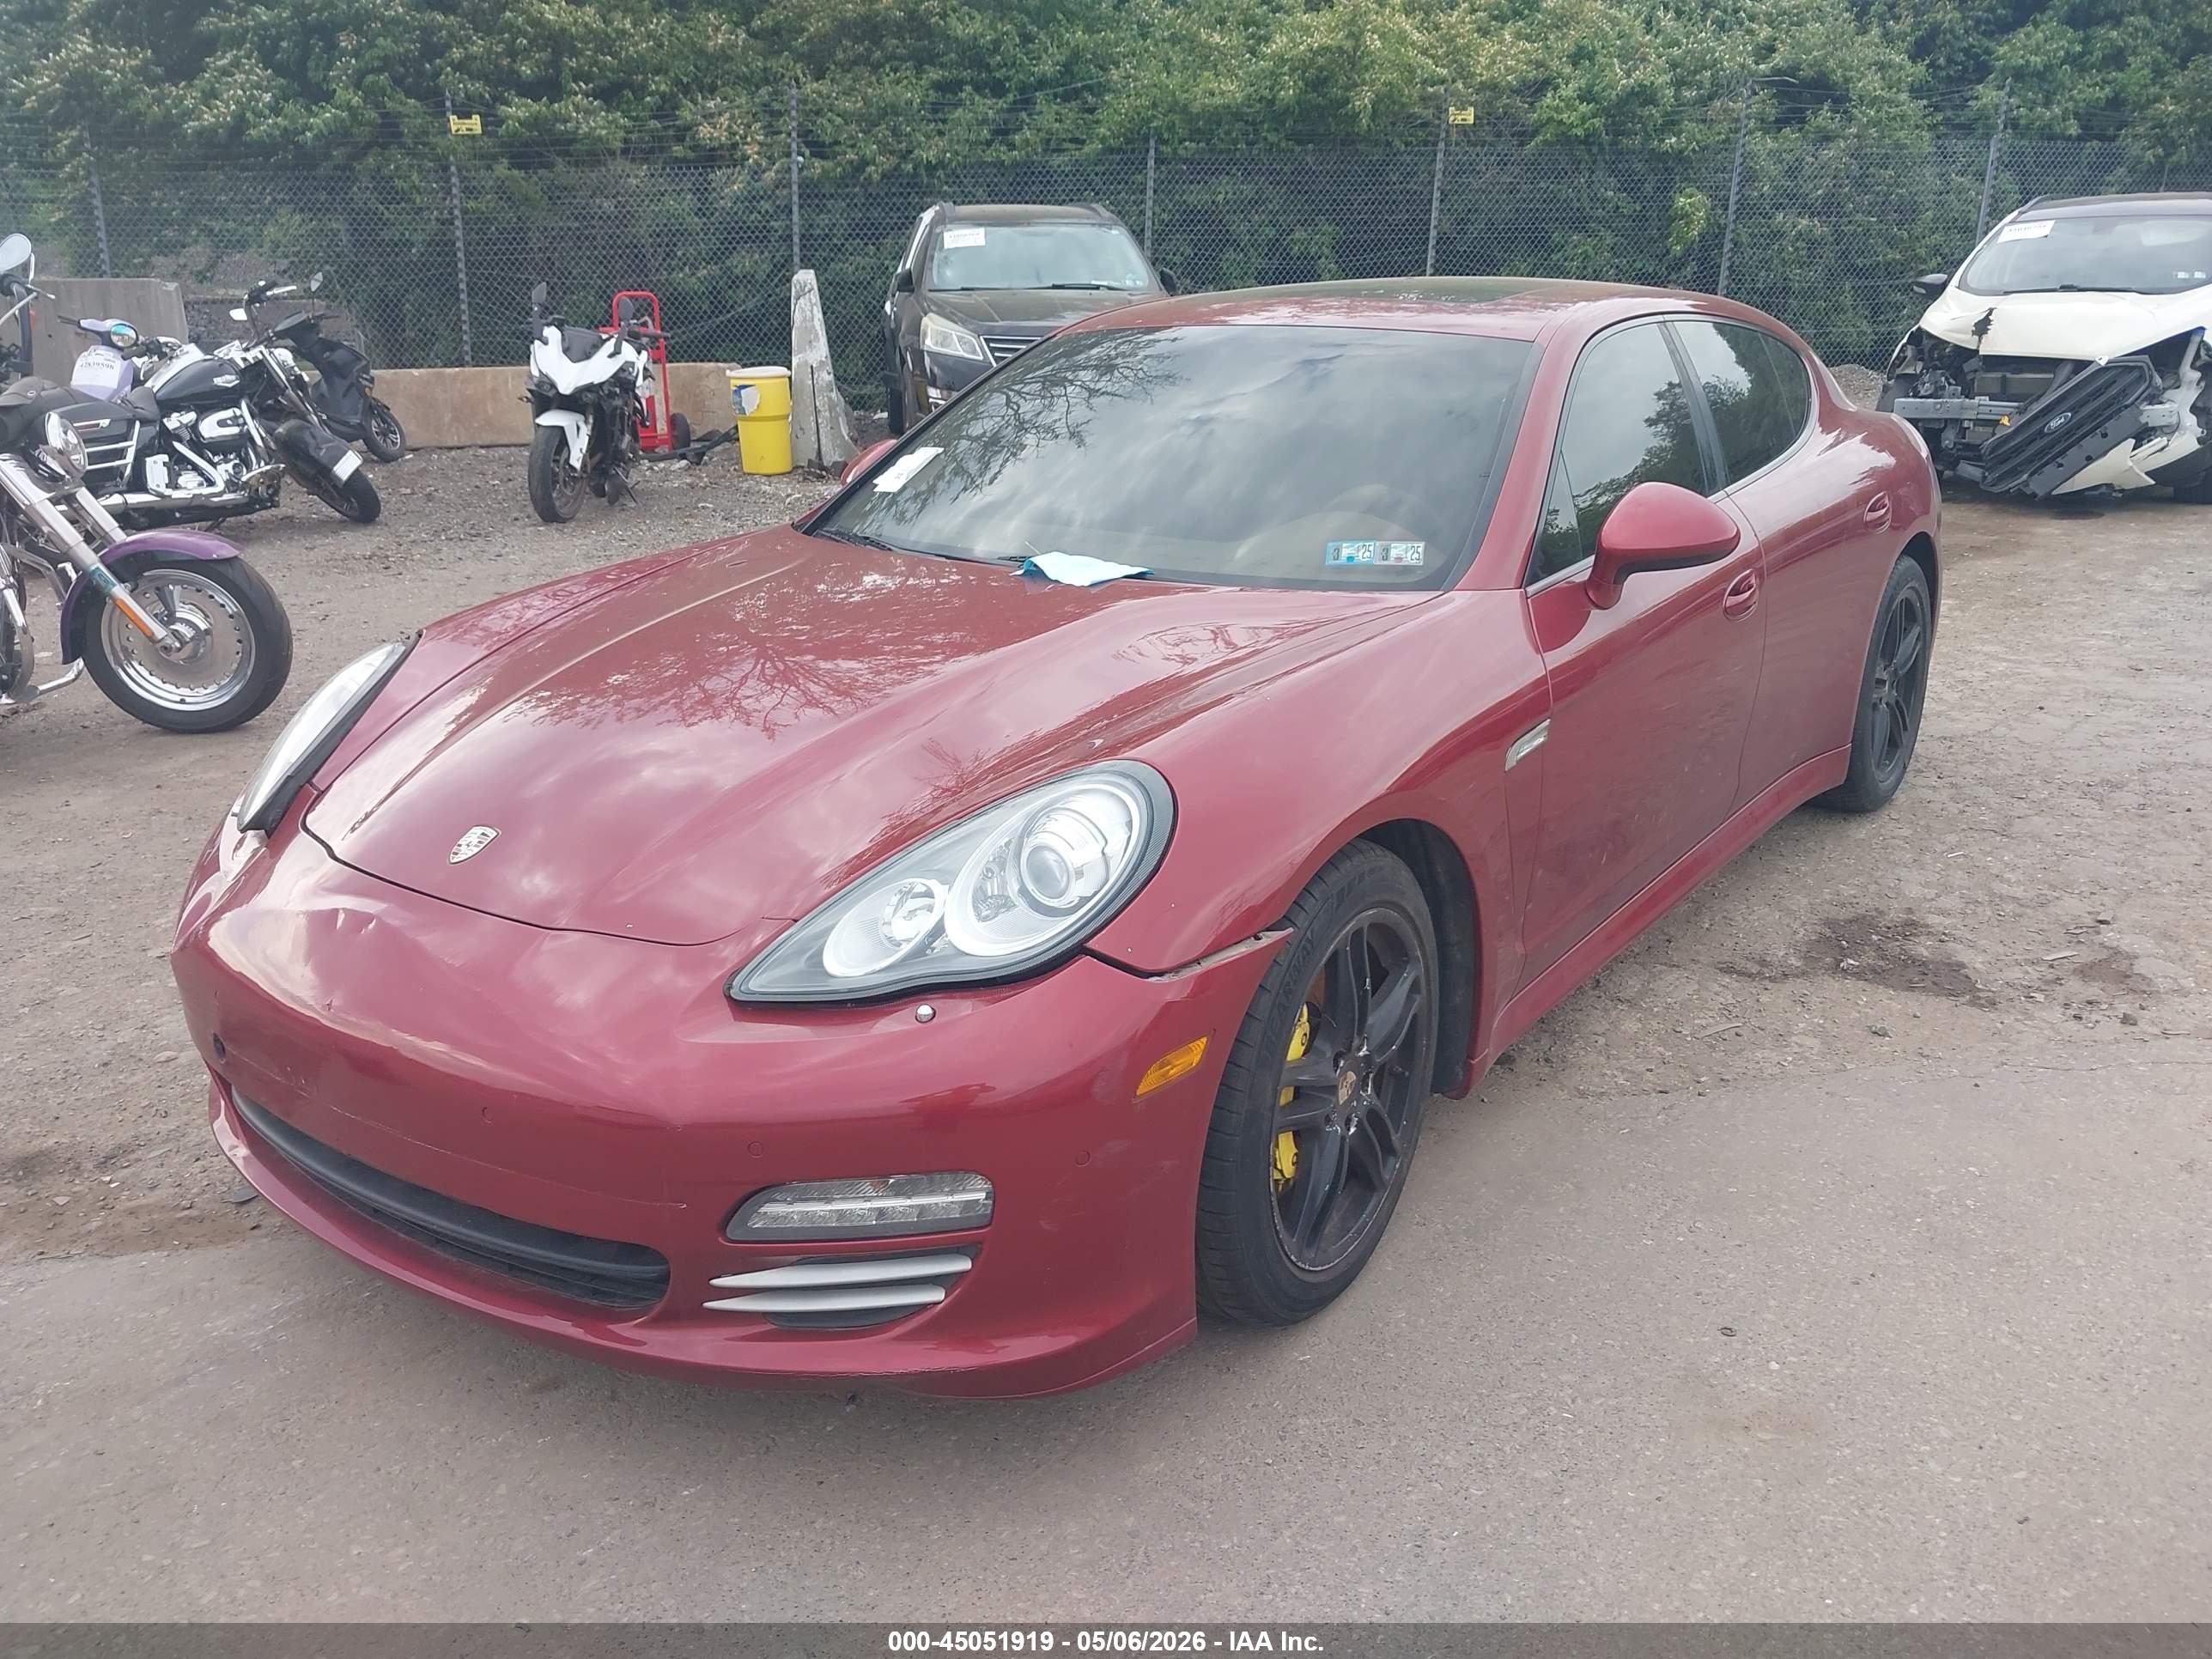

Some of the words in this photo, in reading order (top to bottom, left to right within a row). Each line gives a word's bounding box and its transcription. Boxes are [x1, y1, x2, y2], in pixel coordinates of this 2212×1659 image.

[1333, 548, 1340, 561] 3
[1362, 544, 1373, 559] 25
[1382, 548, 1389, 561] 3
[1410, 545, 1421, 561] 25
